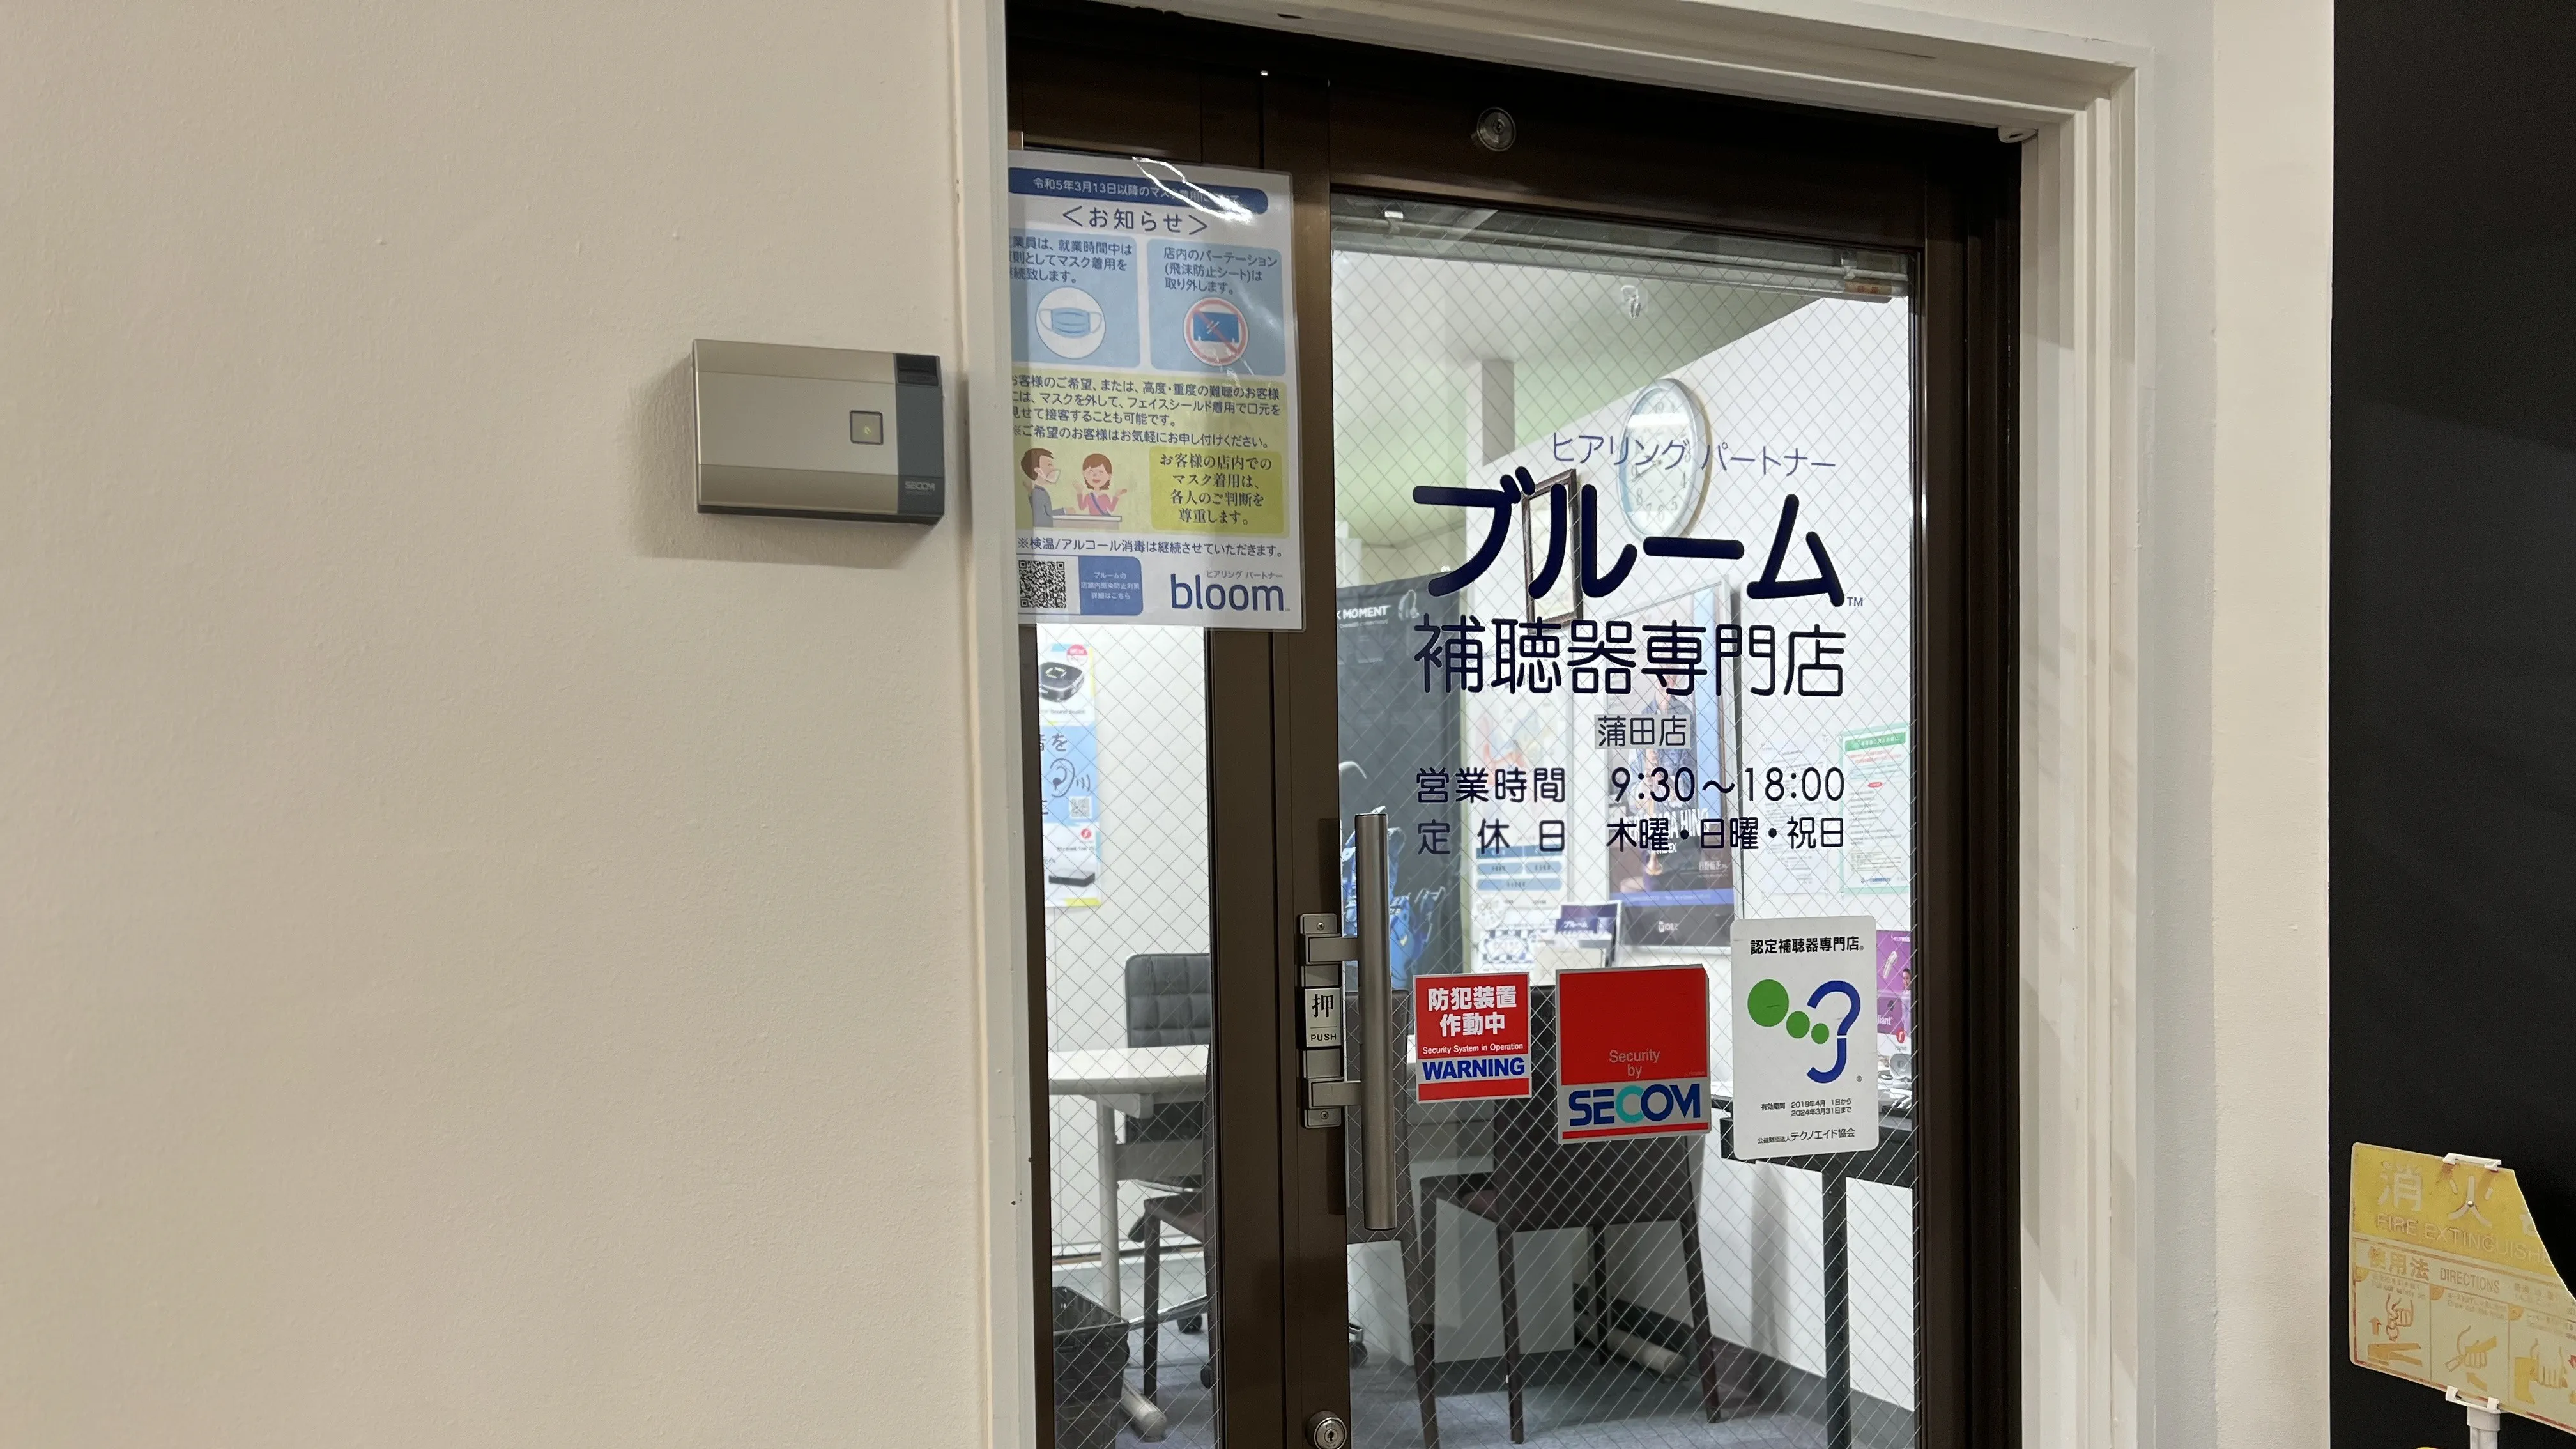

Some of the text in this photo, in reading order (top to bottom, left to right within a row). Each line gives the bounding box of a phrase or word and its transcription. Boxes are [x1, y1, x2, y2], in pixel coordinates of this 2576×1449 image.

[1009, 235, 1133, 256] 業員は、就業時間中は
[1009, 250, 1128, 271] 則としてマスク着用を
[1163, 247, 1277, 267] 店内のパーテーション
[1165, 277, 1233, 295] 取り外します。
[1160, 452, 1272, 471] お客様の店内での
[1553, 433, 1836, 477] ヒアリング パートナー
[1172, 473, 1259, 489] マスク着用は、
[1170, 489, 1264, 507] 各人のご判断を
[1178, 508, 1248, 526] 尊重します。
[1413, 466, 1845, 607] ブルーム
[1206, 570, 1243, 578] ヒアリング
[1170, 574, 1284, 611] bloom
[1343, 605, 1391, 619] MOMENT
[1413, 613, 1846, 697] 補聴器専門店
[1597, 715, 1687, 747] 蒲田店
[1416, 766, 1566, 804] 営業時間
[1606, 816, 1844, 852] 木曜・日曜・祝日
[1312, 993, 1334, 1018] 押
[1427, 985, 1517, 1011] 防犯装置
[1439, 1013, 1505, 1037] 作動中
[1310, 1032, 1337, 1041] PUSH
[1422, 1045, 1452, 1055] Security
[1453, 1044, 1479, 1054] System
[1489, 1042, 1524, 1052] Operation
[1609, 1048, 1660, 1066] Security
[1422, 1057, 1525, 1080] WARNING
[1627, 1064, 1642, 1079] by
[1568, 1083, 1701, 1127] SECOM
[1761, 1103, 1786, 1111] 有効期間
[1791, 1107, 1851, 1116] 2024年3月31日まで
[2376, 1215, 2418, 1237] FIRE
[2440, 1267, 2500, 1294] DIRECTIONS
